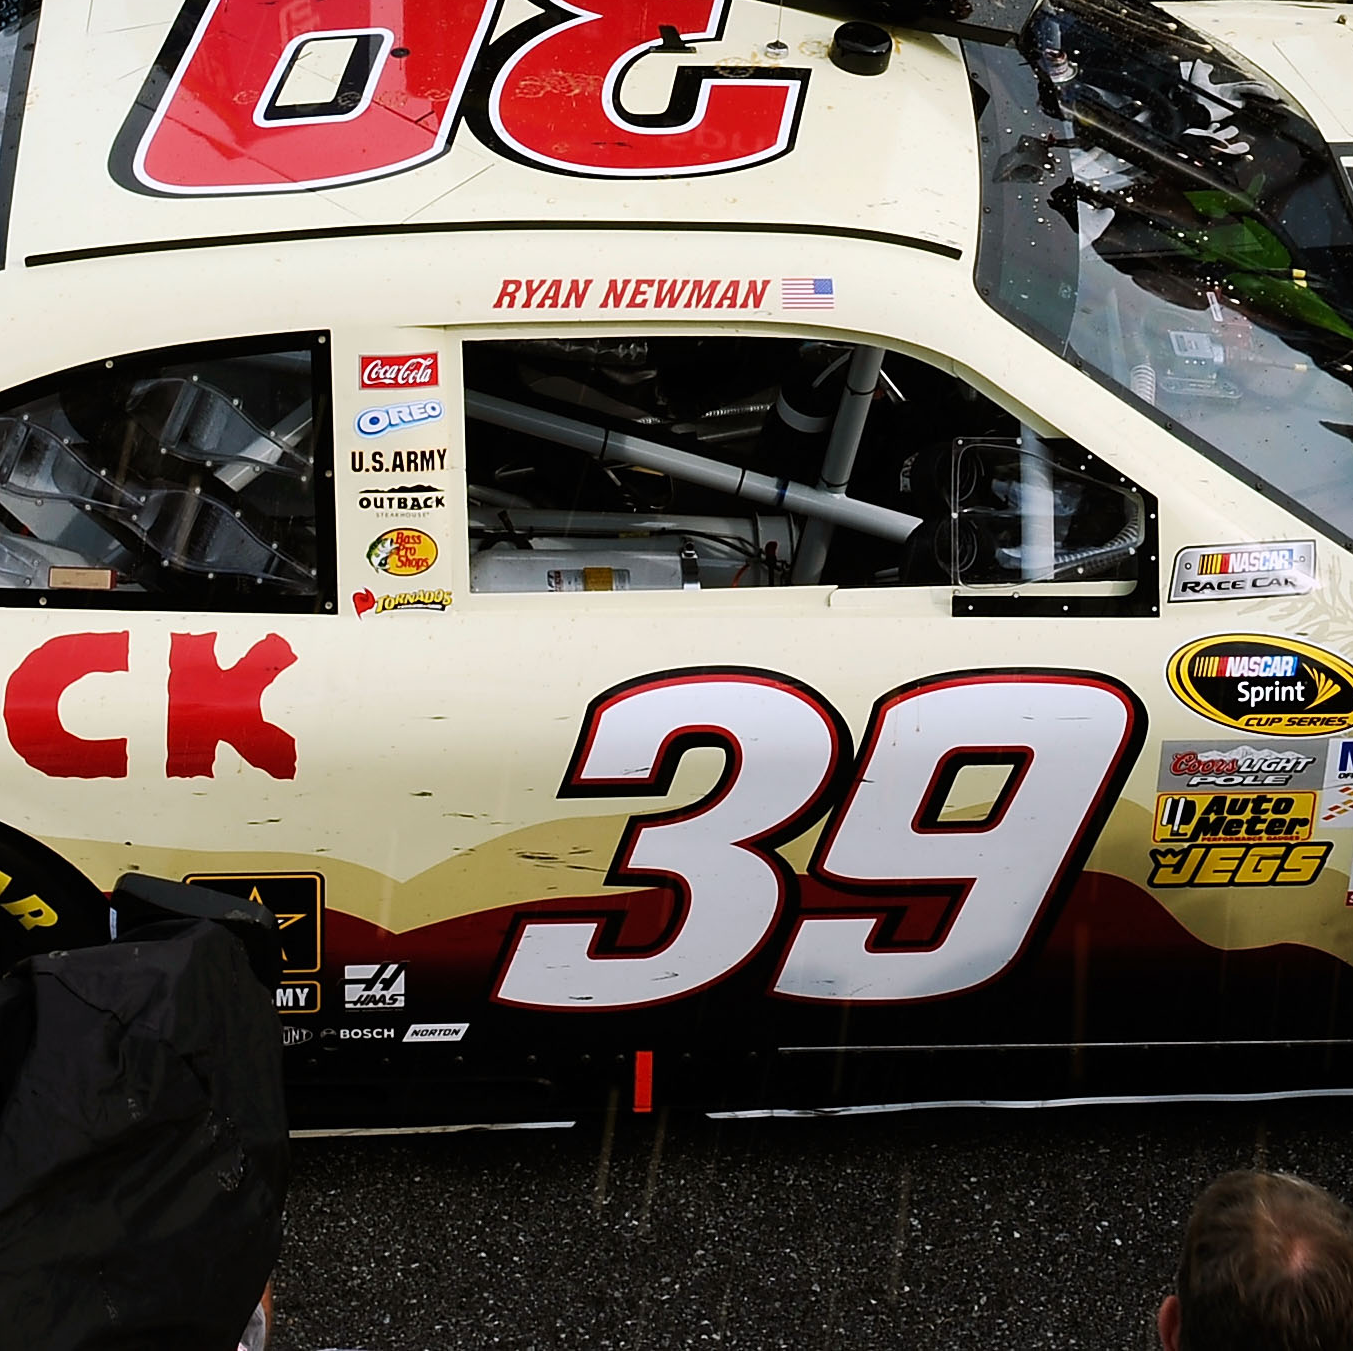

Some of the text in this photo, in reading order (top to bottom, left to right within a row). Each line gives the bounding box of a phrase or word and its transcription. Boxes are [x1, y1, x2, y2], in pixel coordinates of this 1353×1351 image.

[493, 278, 772, 310] RYAN NEWMAN
[362, 355, 435, 387] Coca-Cola
[356, 401, 443, 436] OREO
[358, 495, 445, 511] OUTBACK
[375, 511, 429, 519] STEAKHOUSE
[395, 531, 422, 546] Bass
[395, 545, 417, 557] Pro
[1228, 549, 1295, 573] NASCAR
[395, 555, 430, 571] Shops
[1180, 579, 1245, 594] RACE
[374, 589, 453, 613] TORNADOS
[1225, 656, 1299, 677] NASCAR
[1237, 681, 1307, 708] Sprint
[1244, 716, 1349, 727] CUP SERIES
[1170, 751, 1316, 776] Coors LIGHT
[1187, 774, 1291, 786] POLE
[1199, 795, 1296, 817] Auto
[1196, 816, 1311, 837] Meter
[490, 663, 1150, 1014] 39
[1152, 844, 1328, 885] JEGS
[352, 993, 400, 1007] HAAS
[339, 1027, 396, 1040] BOSCH
[410, 1027, 462, 1038] NORTON
